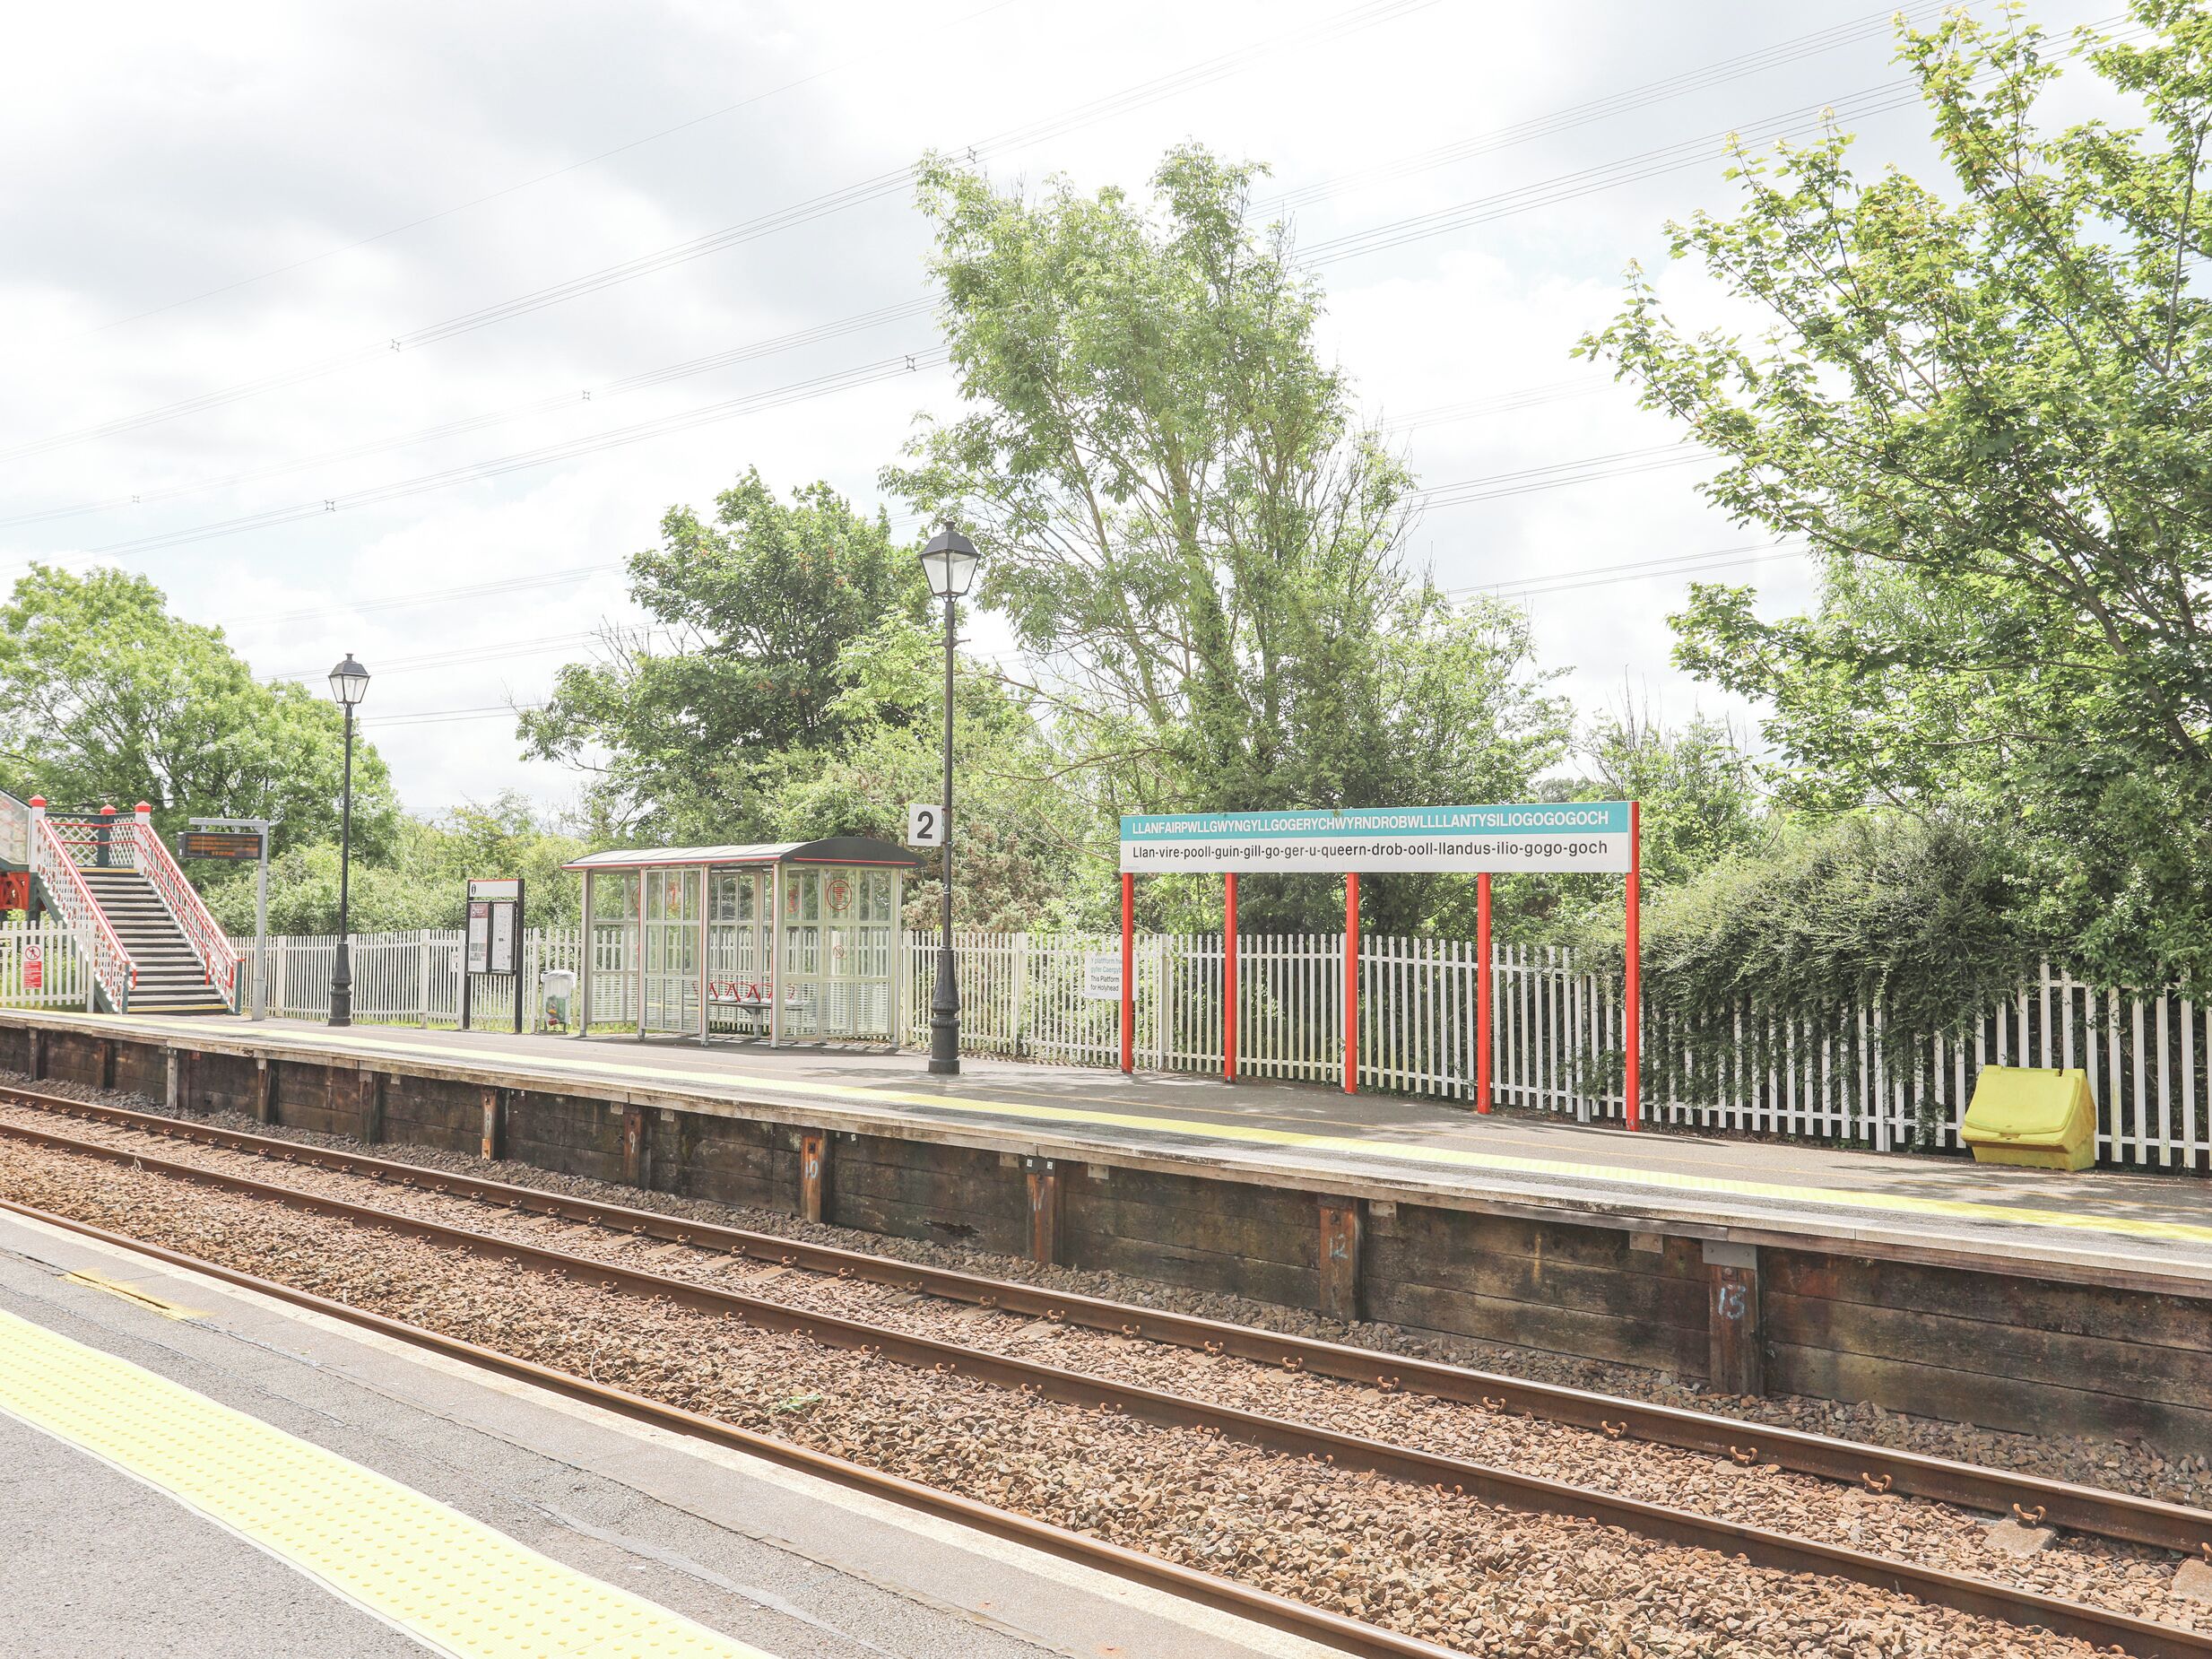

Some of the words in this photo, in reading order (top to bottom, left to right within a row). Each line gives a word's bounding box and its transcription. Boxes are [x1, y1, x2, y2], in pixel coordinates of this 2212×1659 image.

[917, 811, 933, 839] 2
[1132, 811, 1609, 834] LLANFAIRPWLLGWYNGYLLGOGERYCHWYRNDROBWLLLLANTYSILIOGOGOGOCH
[1132, 840, 1608, 860] Llan-vire-pooll-guin-gill-go-ger-u-queern-drob-ooll-llandus-ilio-gogo-goch
[1097, 984, 1119, 992] Holyhead
[1100, 975, 1120, 983] Platform
[629, 1131, 636, 1154] 9
[805, 1160, 819, 1178] 10
[1329, 1233, 1349, 1259] 12
